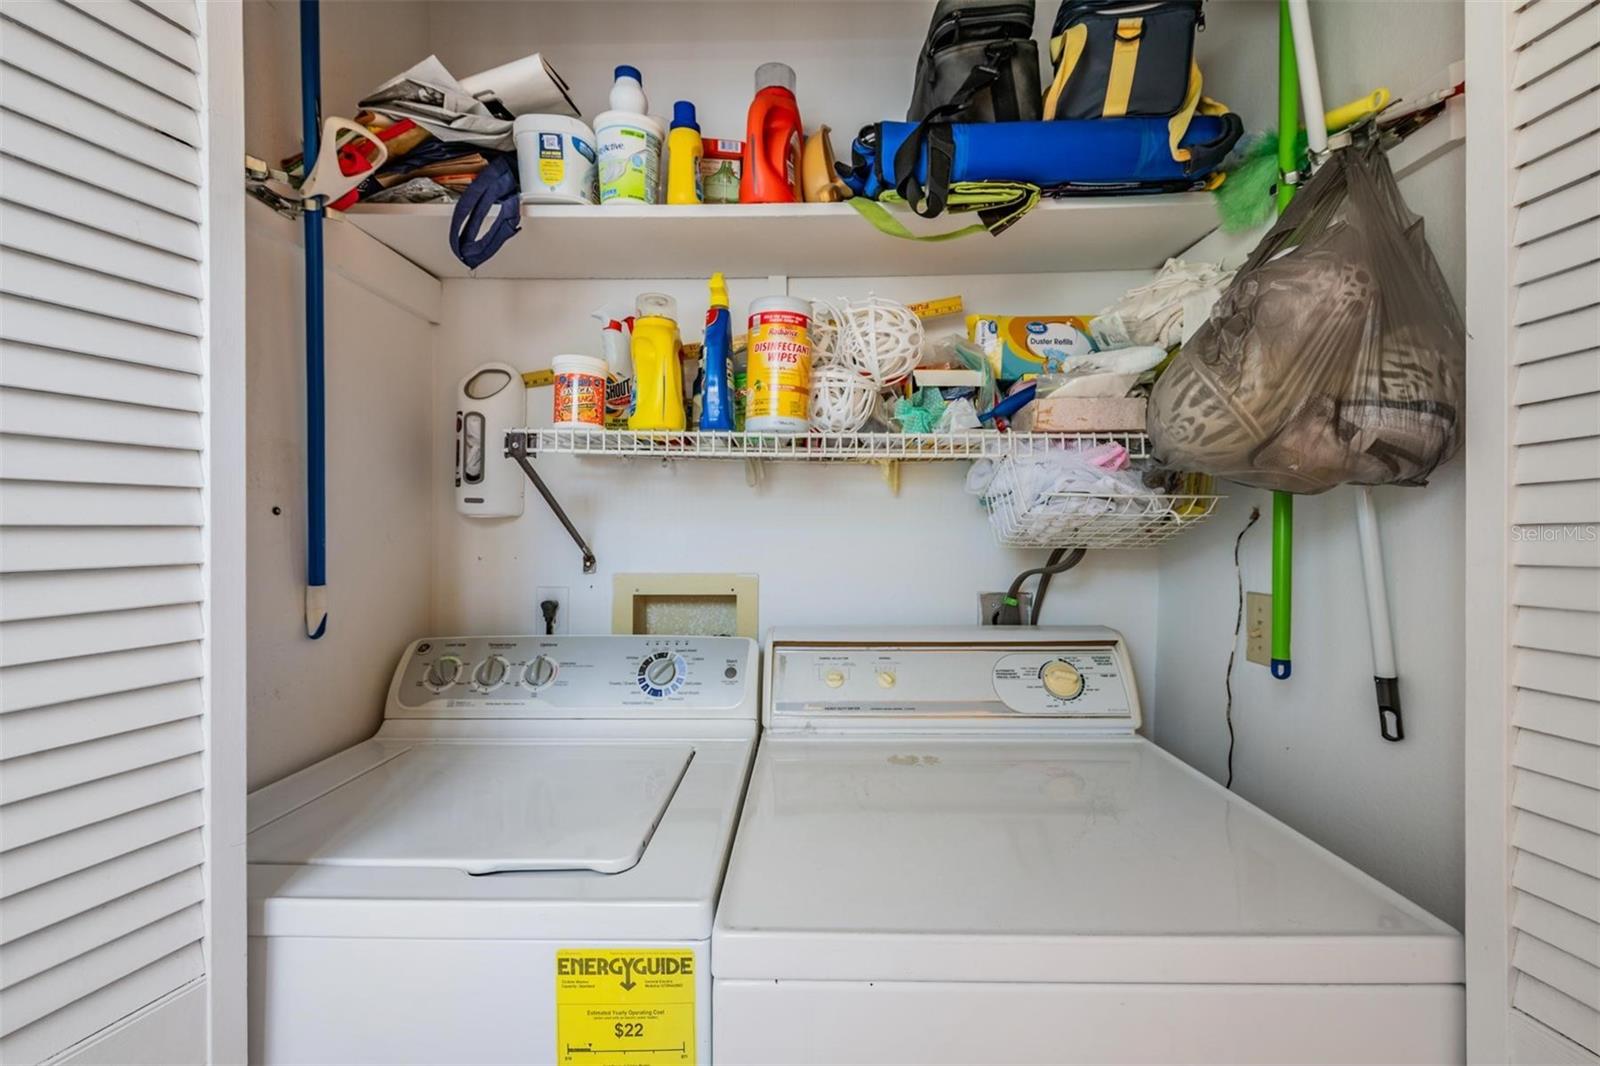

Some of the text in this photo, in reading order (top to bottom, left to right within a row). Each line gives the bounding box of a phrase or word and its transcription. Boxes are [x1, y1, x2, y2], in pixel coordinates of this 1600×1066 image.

[754, 341, 809, 356] DISINFECTANT
[1030, 338, 1073, 346] Duster Refills
[767, 352, 797, 363] WIPES
[606, 378, 631, 400] SHOUT
[557, 957, 693, 976] ENERGYGUIDE
[614, 1022, 644, 1039] $22
